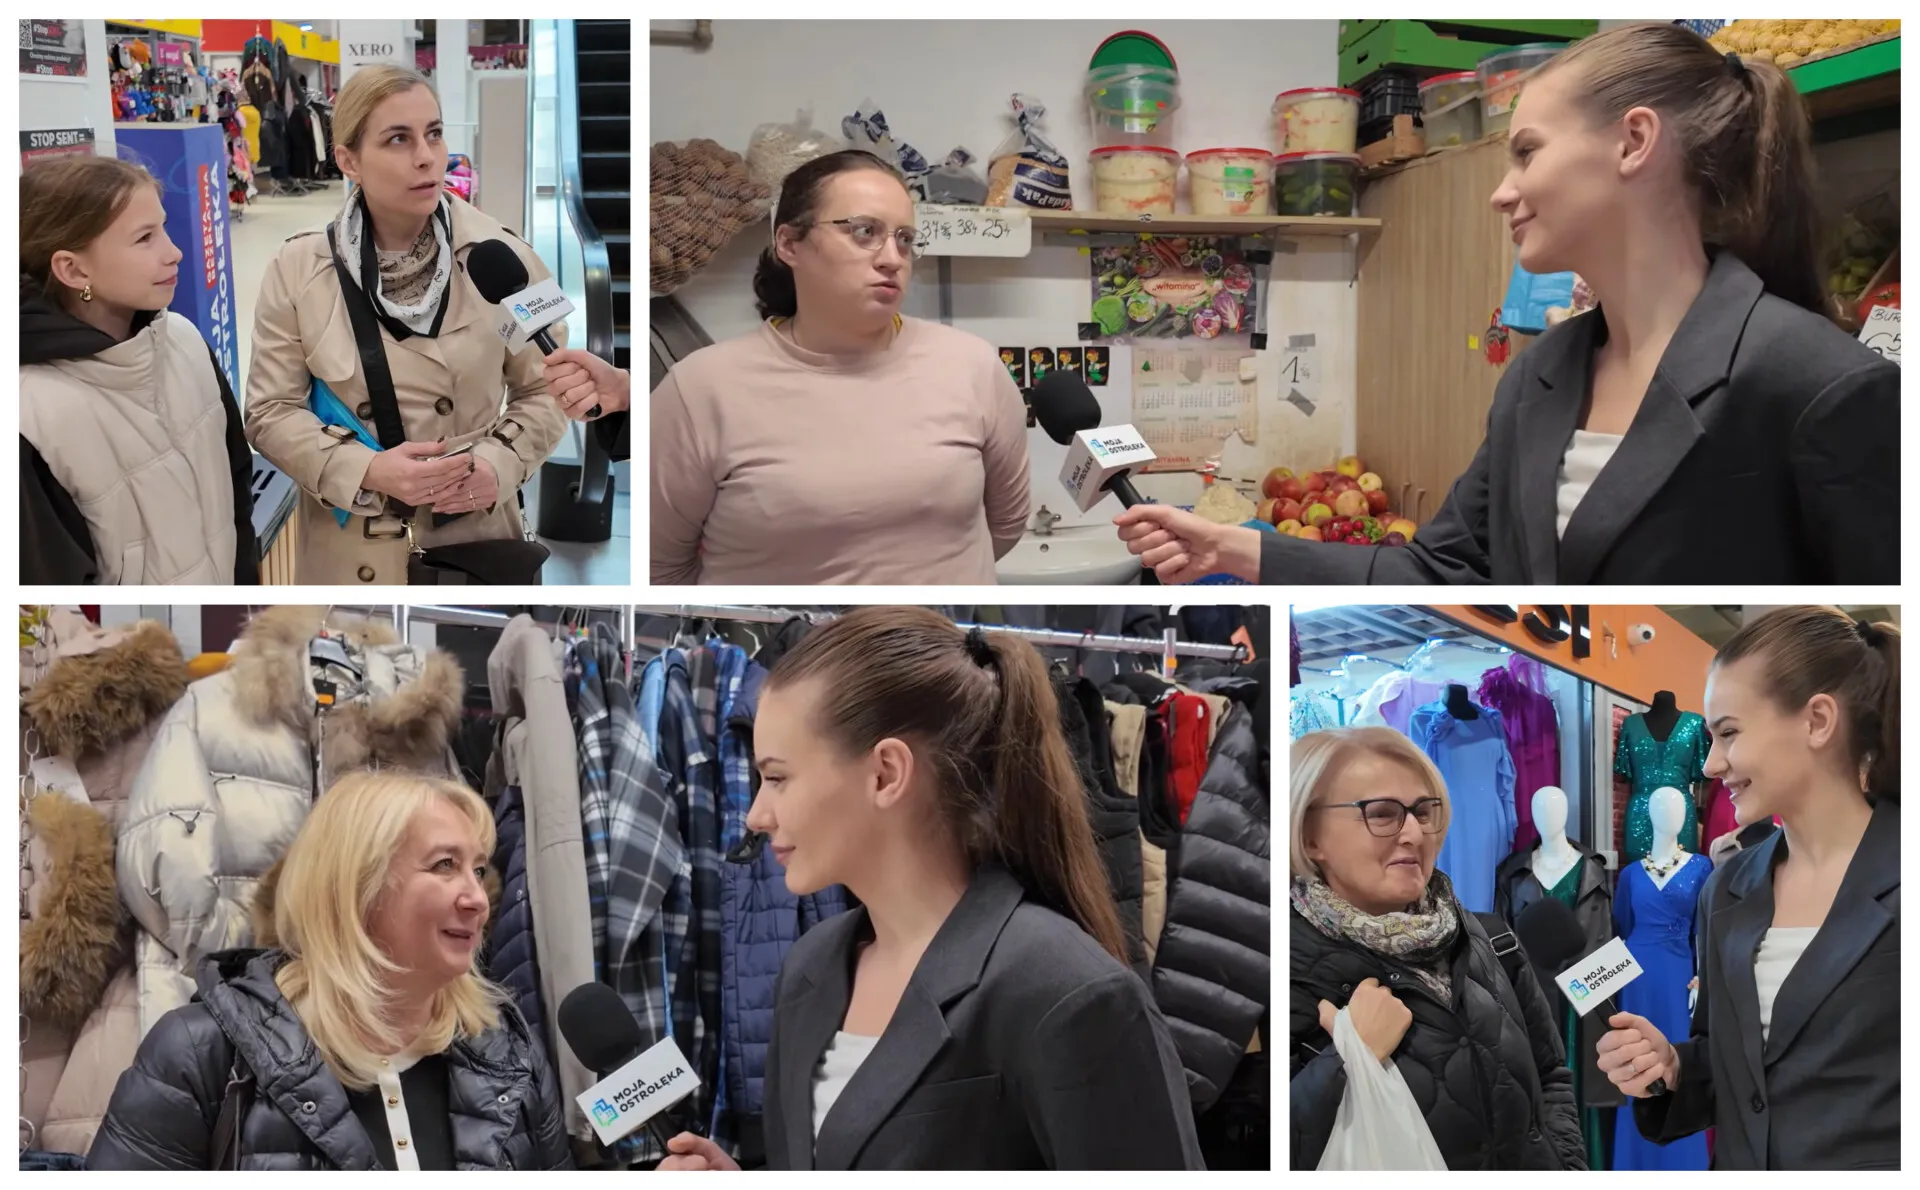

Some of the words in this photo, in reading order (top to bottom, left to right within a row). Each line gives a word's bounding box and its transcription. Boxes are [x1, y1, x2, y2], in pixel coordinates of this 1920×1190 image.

[348, 43, 393, 57] XERO
[30, 132, 54, 148] STOP
[55, 130, 78, 146] SENT
[203, 171, 216, 281] BEZPŁATNA
[202, 212, 212, 284] GAZETA
[211, 160, 234, 390] OSTROŁĘKA
[525, 297, 544, 309] MOJA
[210, 294, 223, 369] OJA
[1102, 438, 1123, 447] MOJA
[1583, 965, 1607, 984] MOJA
[1589, 958, 1632, 991] OSTROŁĘKA
[612, 1079, 647, 1104] MOJA
[619, 1066, 685, 1113] OSTROŁĘKA
